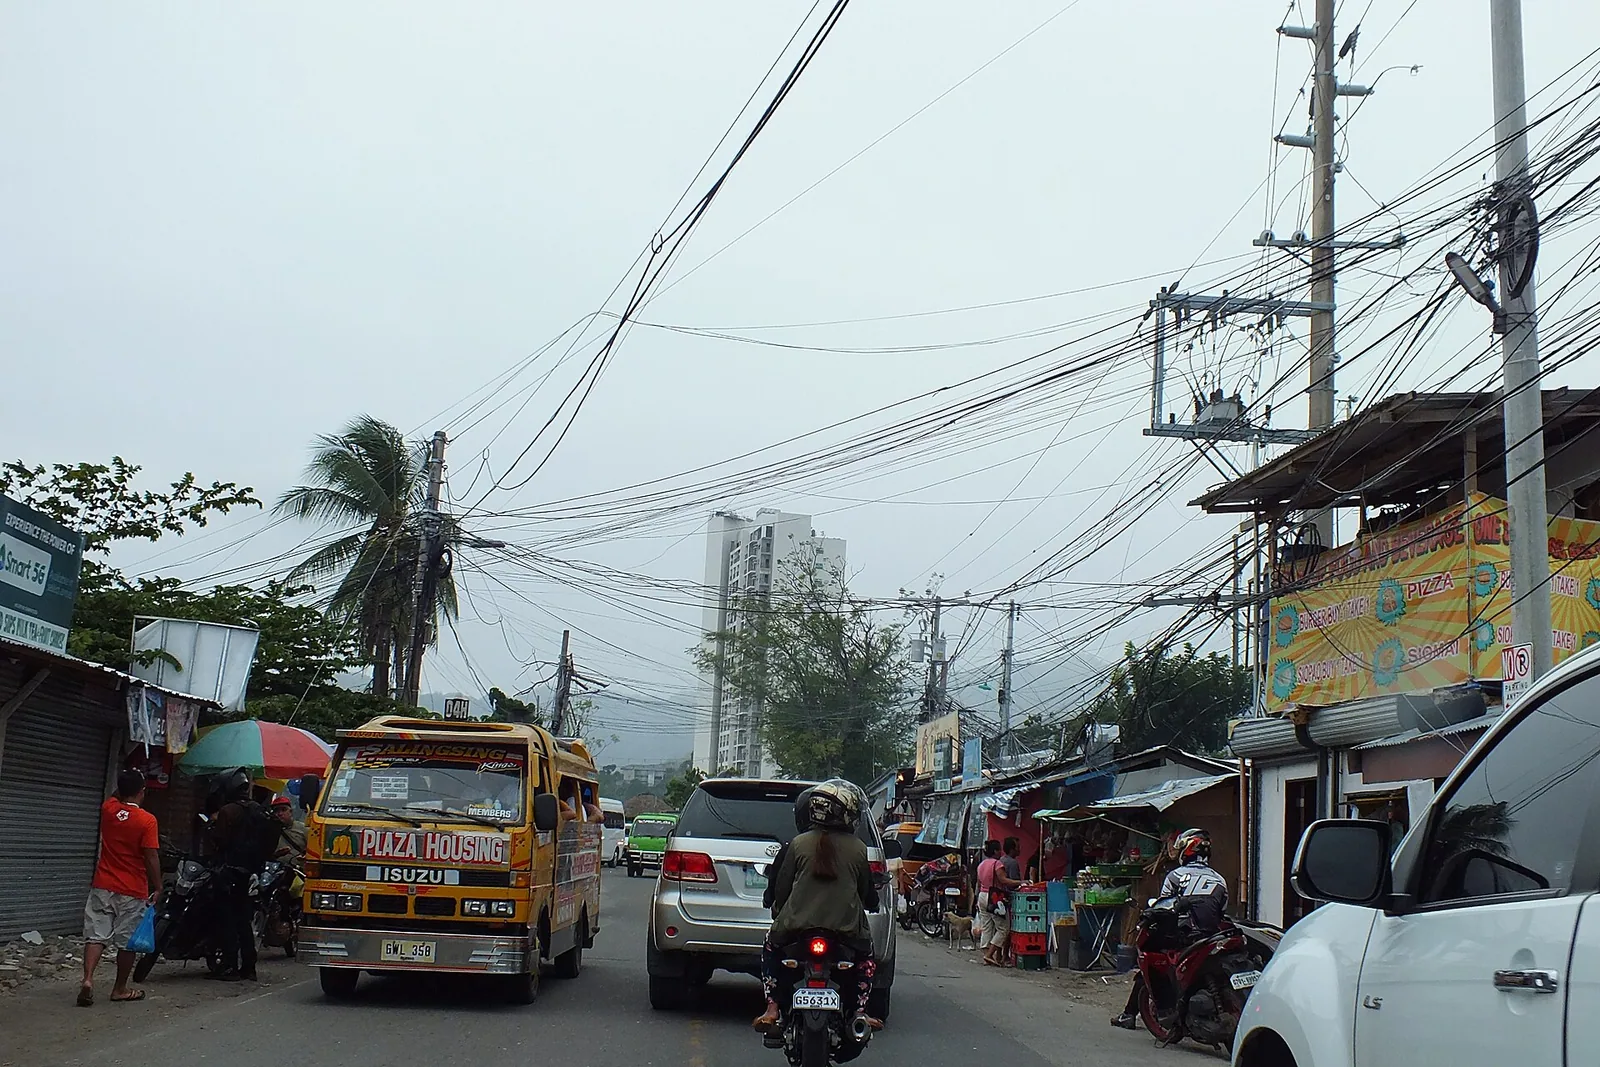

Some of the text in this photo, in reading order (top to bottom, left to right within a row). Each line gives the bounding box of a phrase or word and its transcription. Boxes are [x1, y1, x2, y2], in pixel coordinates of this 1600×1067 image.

[5, 513, 76, 555] EXPERIENCE THE POWER OF
[5, 550, 32, 580] Smart
[31, 562, 46, 585] 5G
[1407, 572, 1454, 600] PIZZA
[1556, 574, 1575, 596] TAKE
[1497, 626, 1512, 643] SIO
[1407, 639, 1459, 664] SIOMAI
[1502, 650, 1514, 680] NO
[1504, 682, 1528, 691] PARKING
[446, 700, 469, 719] 04H
[361, 744, 506, 760] SALINGSING
[468, 807, 511, 818] MEMBERS
[362, 829, 503, 863] PLAZA HOUSING
[383, 867, 443, 884] ISUZU
[386, 943, 431, 957] GWL 358
[795, 996, 838, 1006] G5631X
